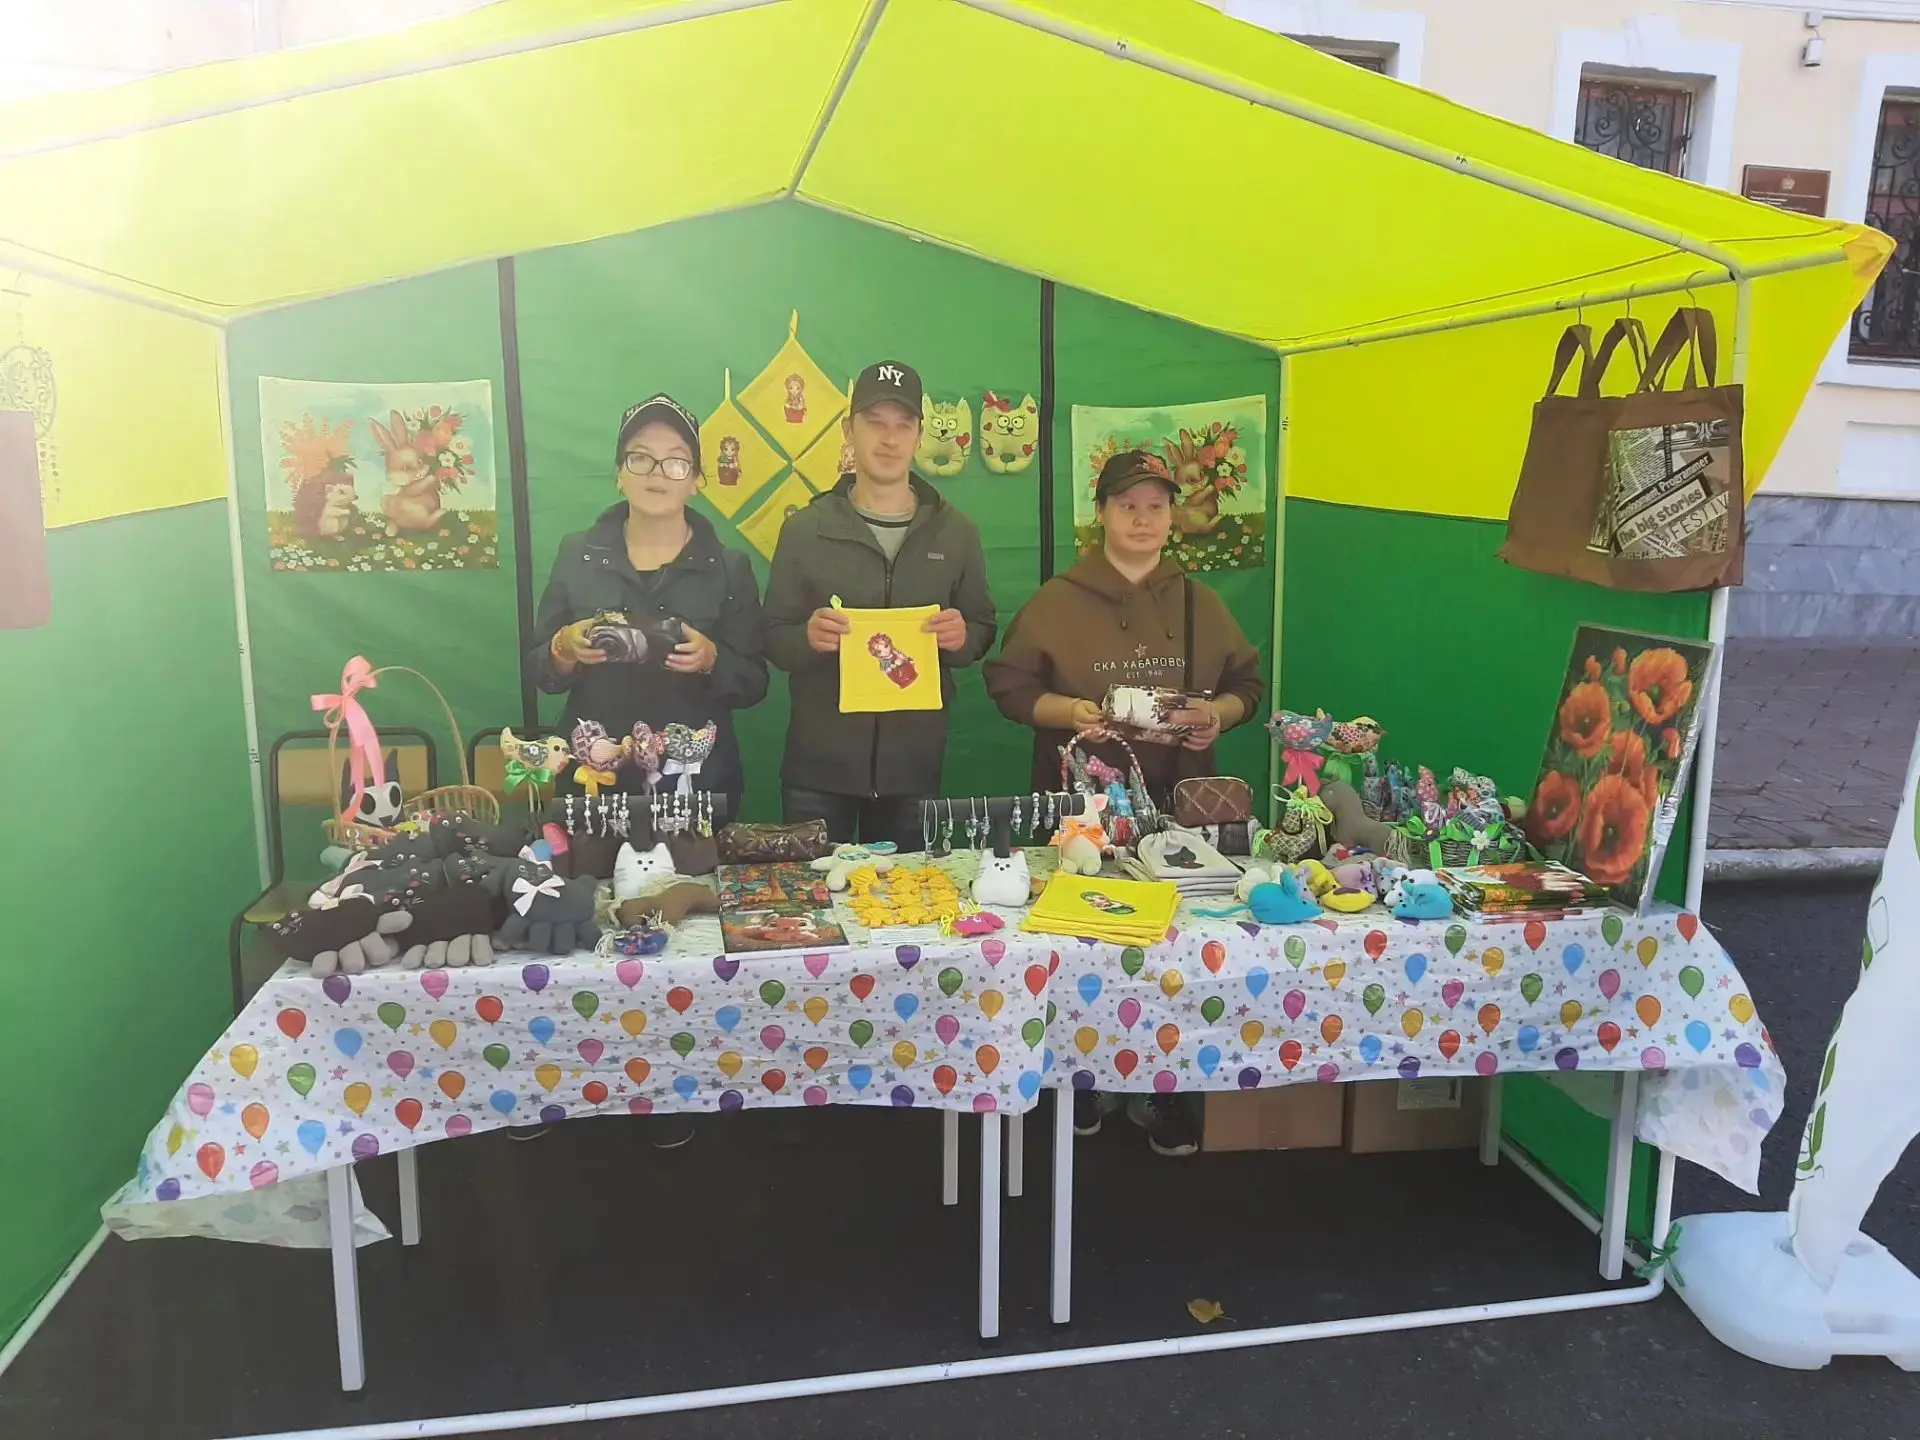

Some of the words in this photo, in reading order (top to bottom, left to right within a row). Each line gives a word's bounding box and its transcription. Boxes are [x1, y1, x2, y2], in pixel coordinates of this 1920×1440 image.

[877, 364, 905, 387] NY
[1620, 525, 1637, 545] The
[1635, 512, 1659, 533] big
[1657, 488, 1703, 521] stories
[1093, 660, 1117, 672] СКА
